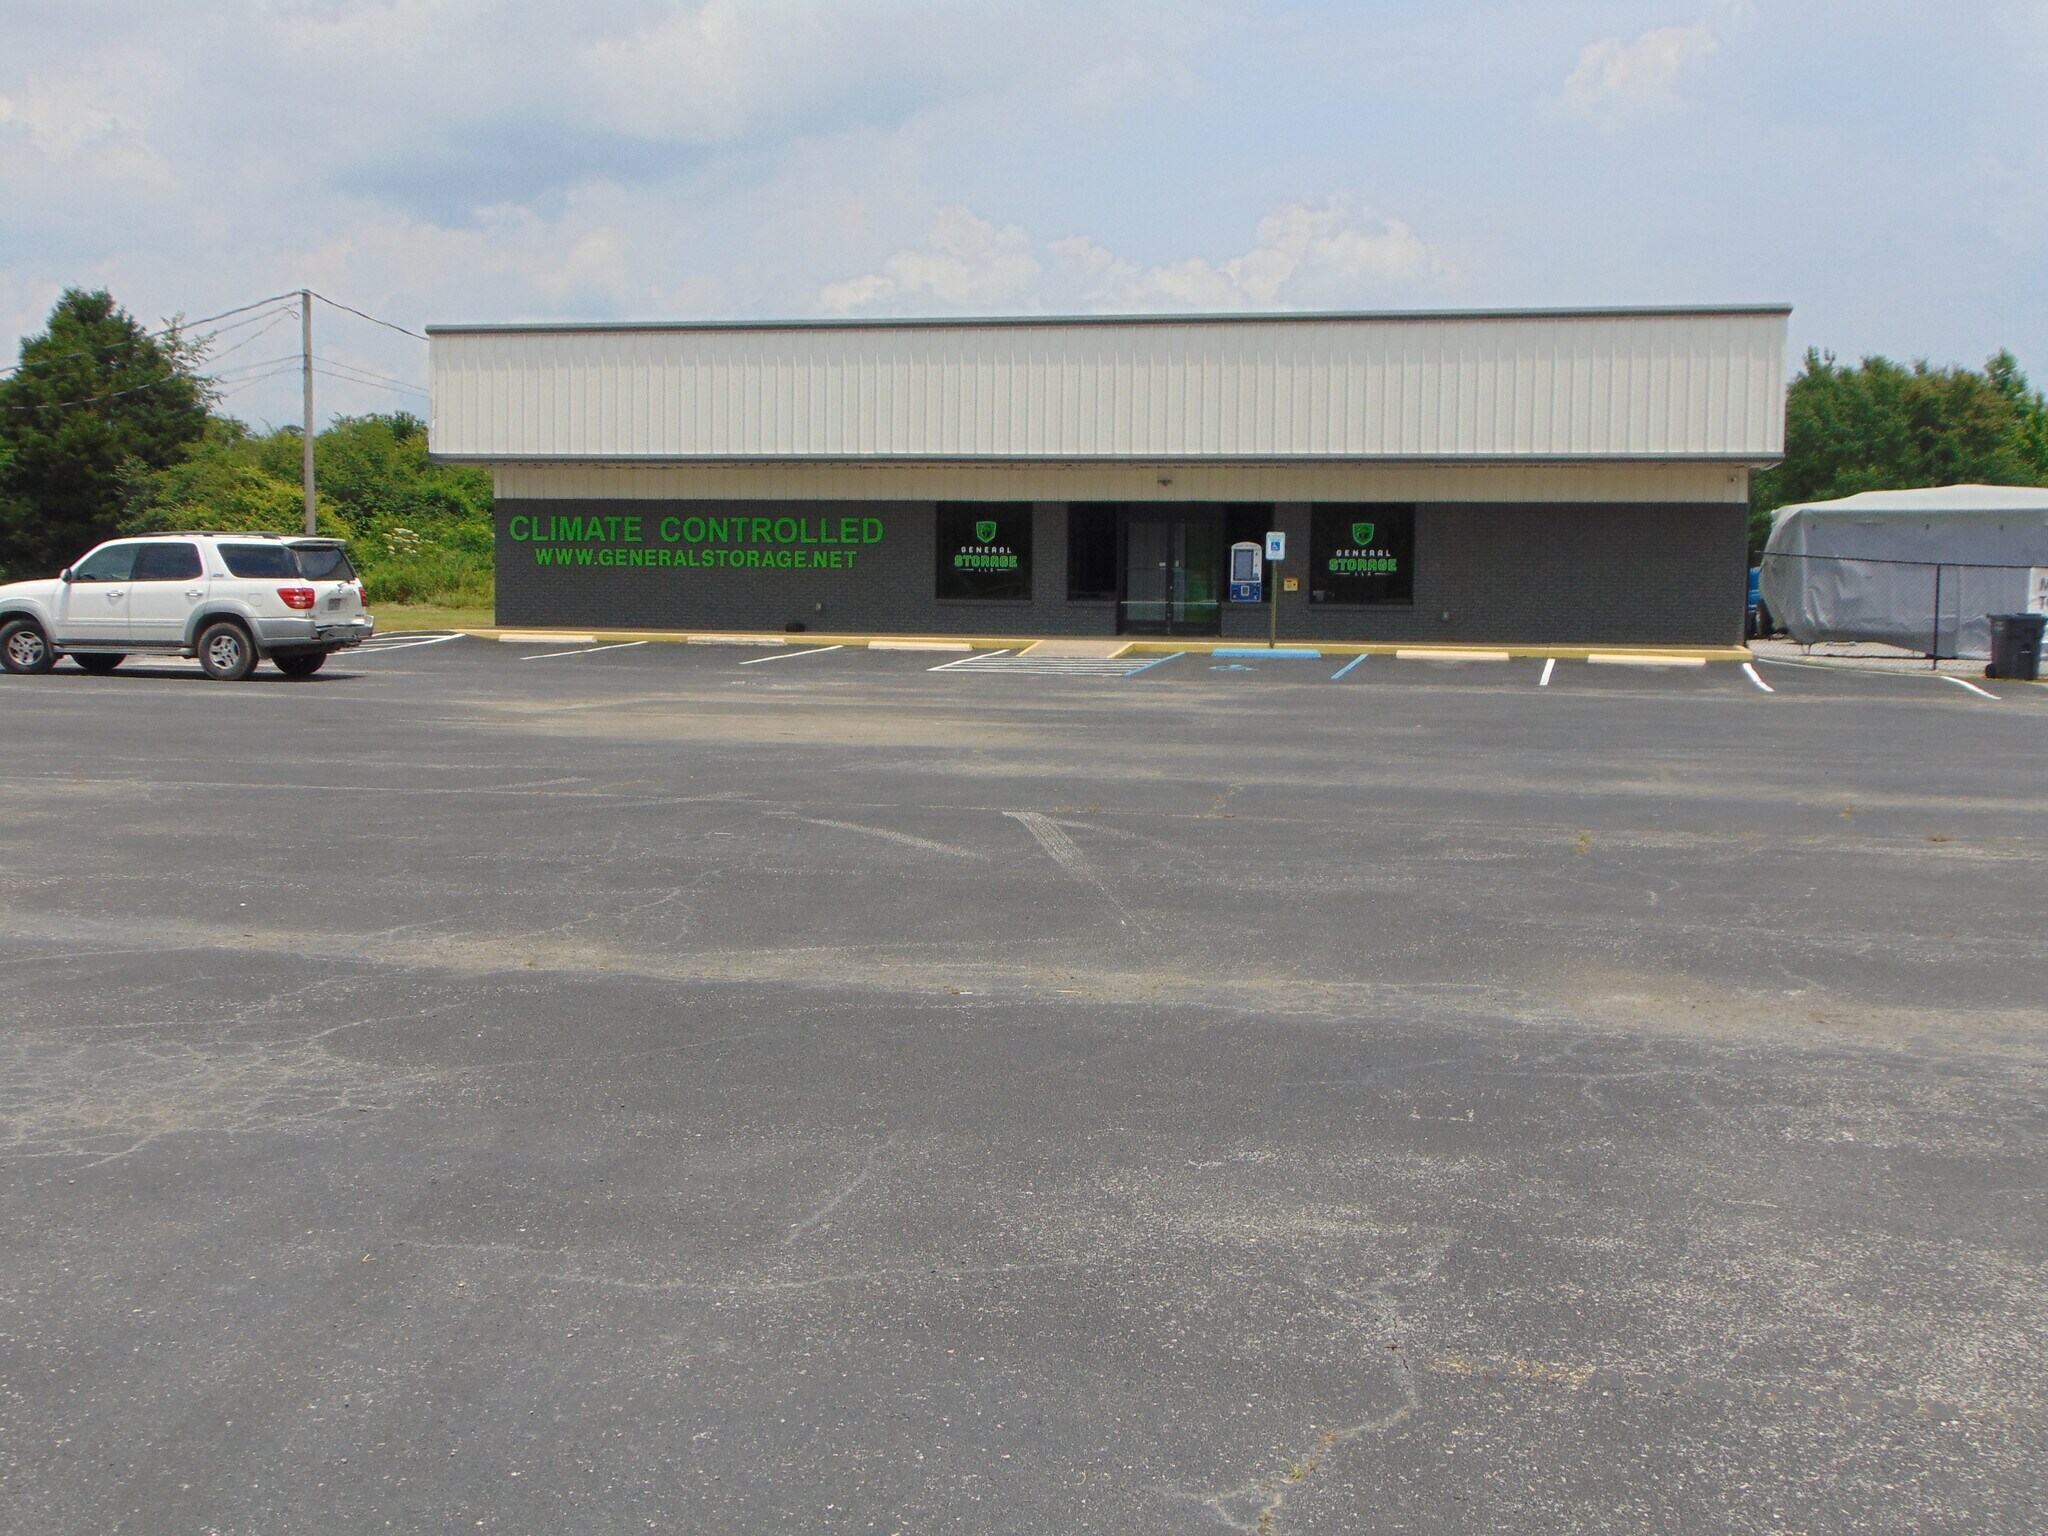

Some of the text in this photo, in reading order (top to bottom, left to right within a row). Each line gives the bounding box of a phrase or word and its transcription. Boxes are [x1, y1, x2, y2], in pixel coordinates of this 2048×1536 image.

[509, 516, 884, 544] CLIMATE CONTROLLED
[961, 546, 1012, 554] GENERAL
[1336, 549, 1391, 557] GENERAL
[535, 548, 857, 569] WWW.GENERALSTORAGE.NET
[954, 555, 1017, 568] STORAGE
[1328, 558, 1397, 571] STORAGE
